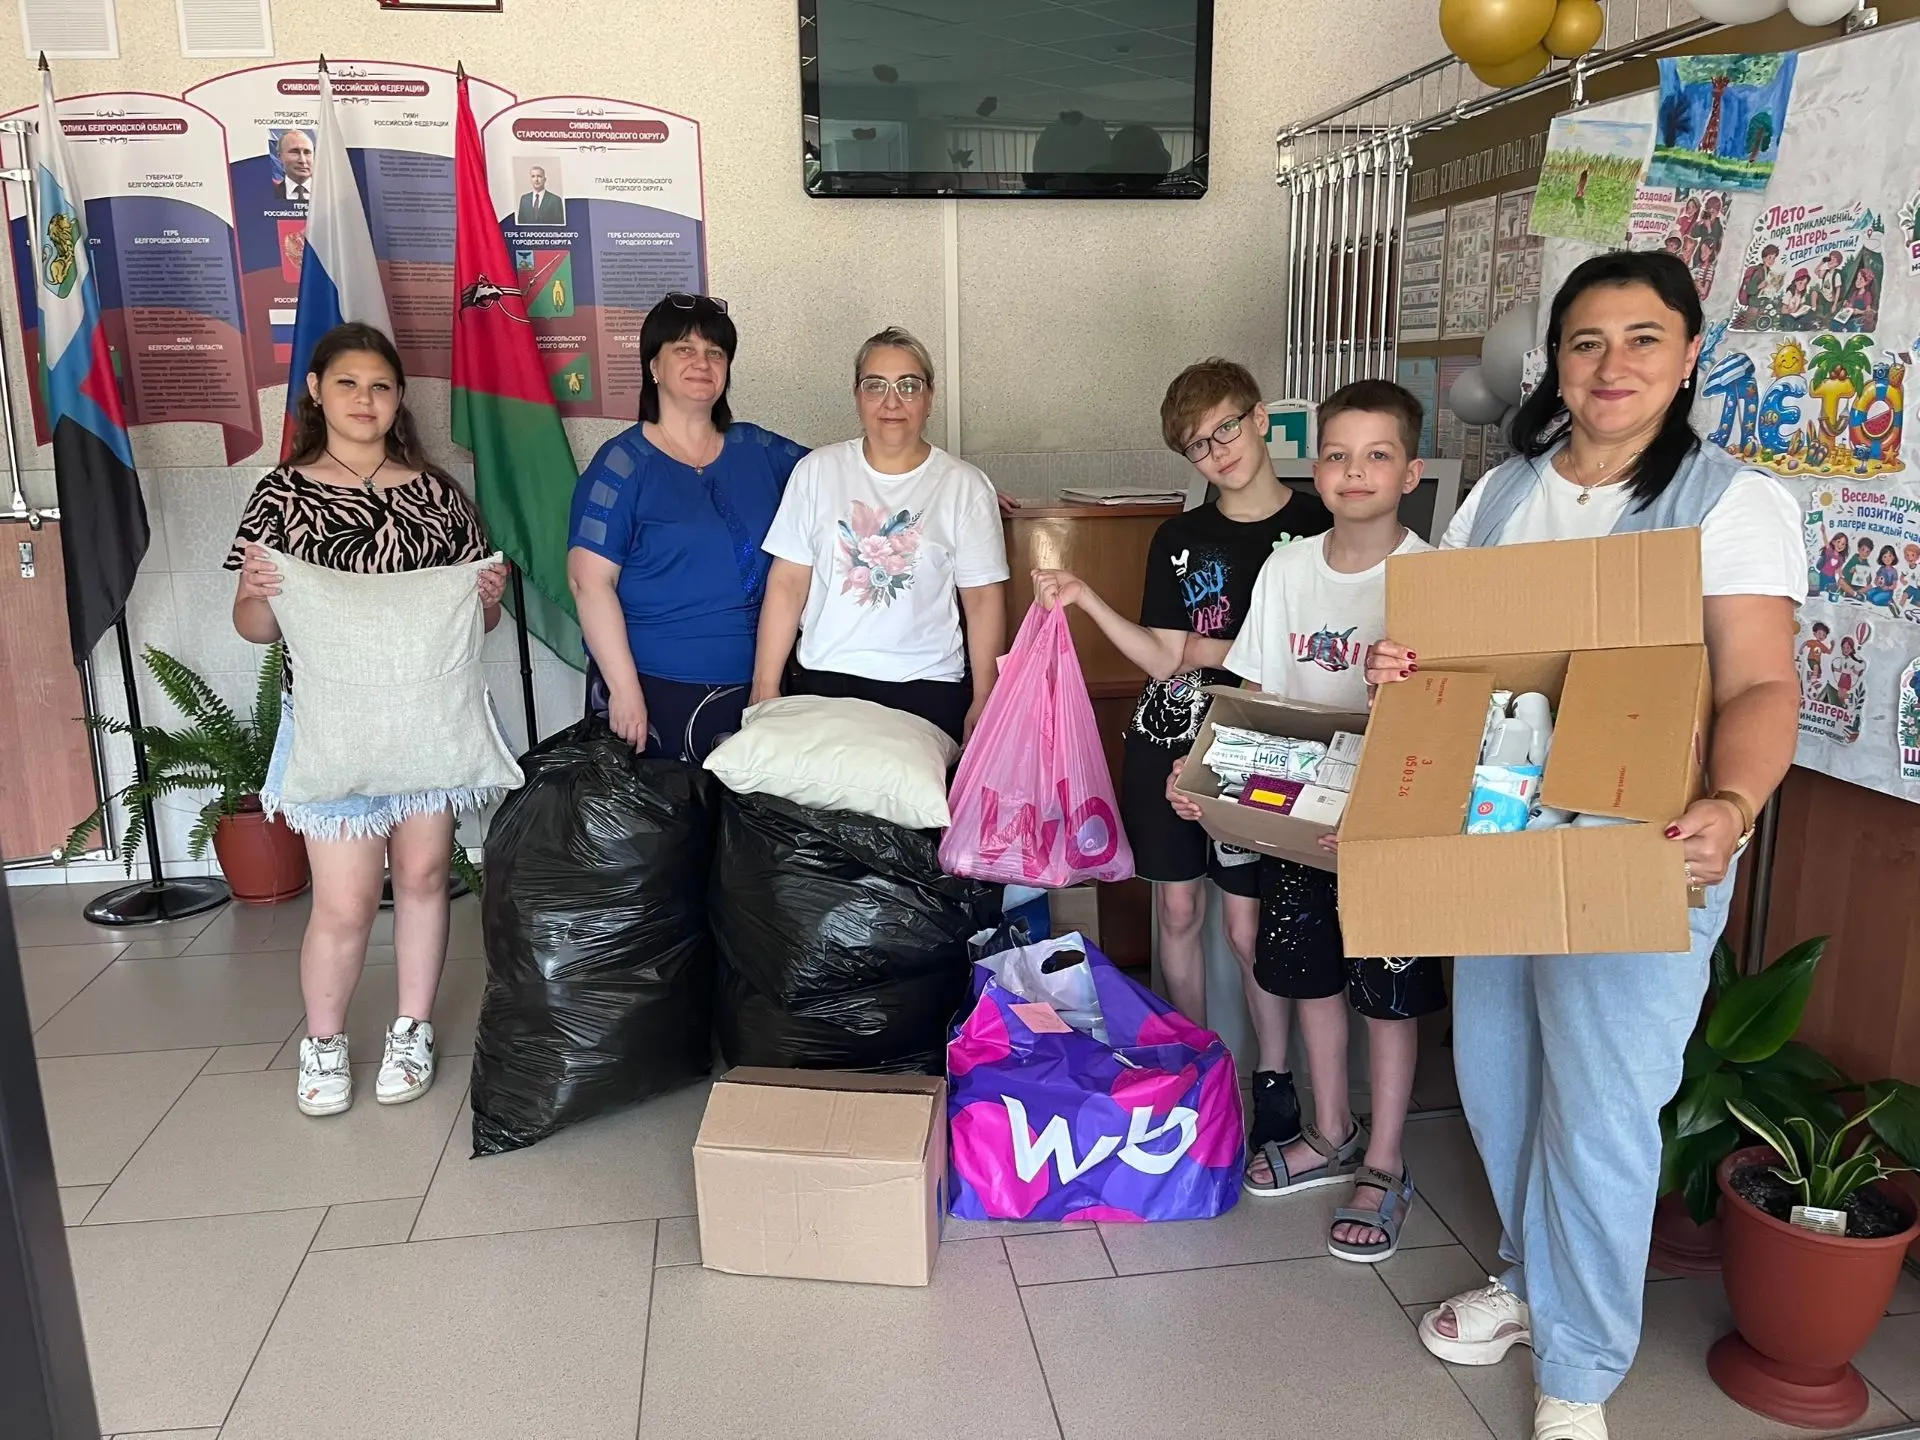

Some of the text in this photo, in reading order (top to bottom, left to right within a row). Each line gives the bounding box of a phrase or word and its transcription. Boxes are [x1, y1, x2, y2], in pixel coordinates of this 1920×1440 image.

[282, 82, 425, 93] СИМВОЛИ РОССИЙСКОЙ ФЕДЕРАЦИИ
[88, 124, 146, 132] БЕЛГОРОДСКОЙ
[569, 122, 612, 130] СИМВОЛИКА
[516, 131, 666, 140] СТАРООСКОЛЬСКОГО ГОРОДСКОГО ОКРУГА
[1633, 220, 1670, 232] надолго!
[1767, 205, 1805, 230] Лето
[1770, 211, 1856, 240] пора приключений,
[1789, 235, 1860, 262] старт открытий!
[1701, 352, 1905, 460] ЛЕТО
[1841, 487, 1920, 513] Веселье, друж
[1857, 506, 1904, 524] позитив
[1829, 520, 1835, 528] в
[1836, 520, 1866, 532] лагере
[1868, 523, 1903, 537] каждый
[1800, 712, 1836, 729] инается
[1809, 700, 1854, 724] лагерь:
